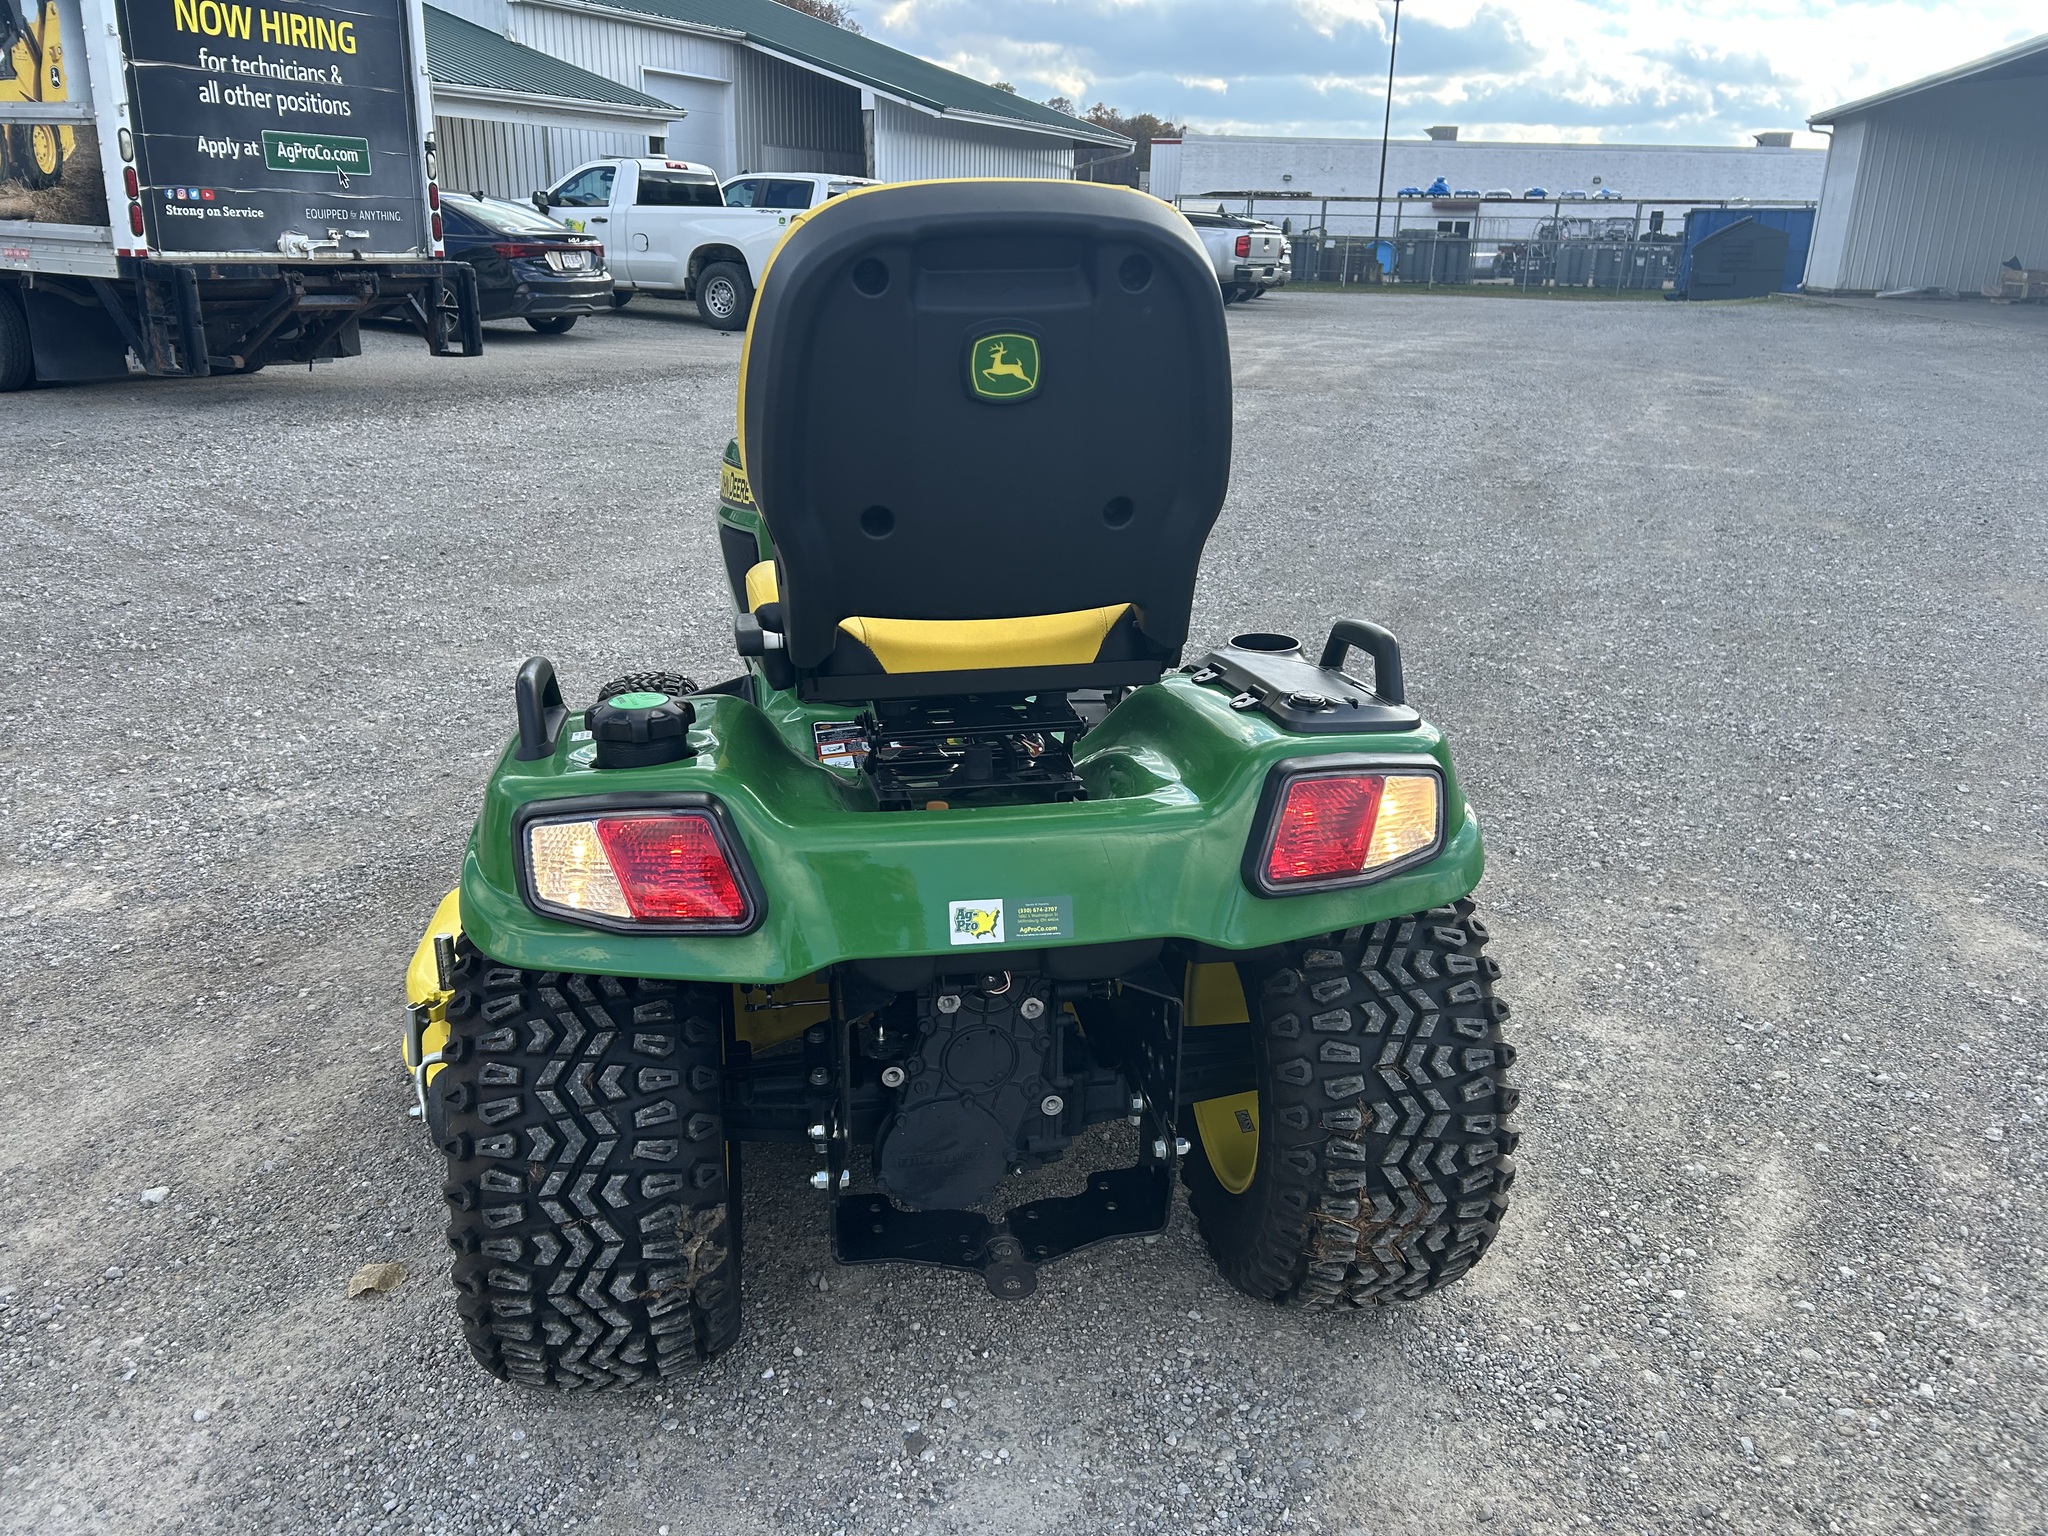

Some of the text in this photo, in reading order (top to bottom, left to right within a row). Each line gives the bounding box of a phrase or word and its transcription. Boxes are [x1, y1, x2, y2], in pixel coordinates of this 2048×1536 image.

[174, 0, 357, 54] NOW HIRING
[199, 48, 343, 84] for technicians &
[199, 80, 352, 117] all other positions
[197, 136, 359, 163] Apply at AgProCo.com
[165, 204, 264, 219] Strong on Service
[305, 208, 349, 220] EQUIPPED
[359, 210, 404, 222] ANYTHING.
[956, 920, 979, 932] Pro
